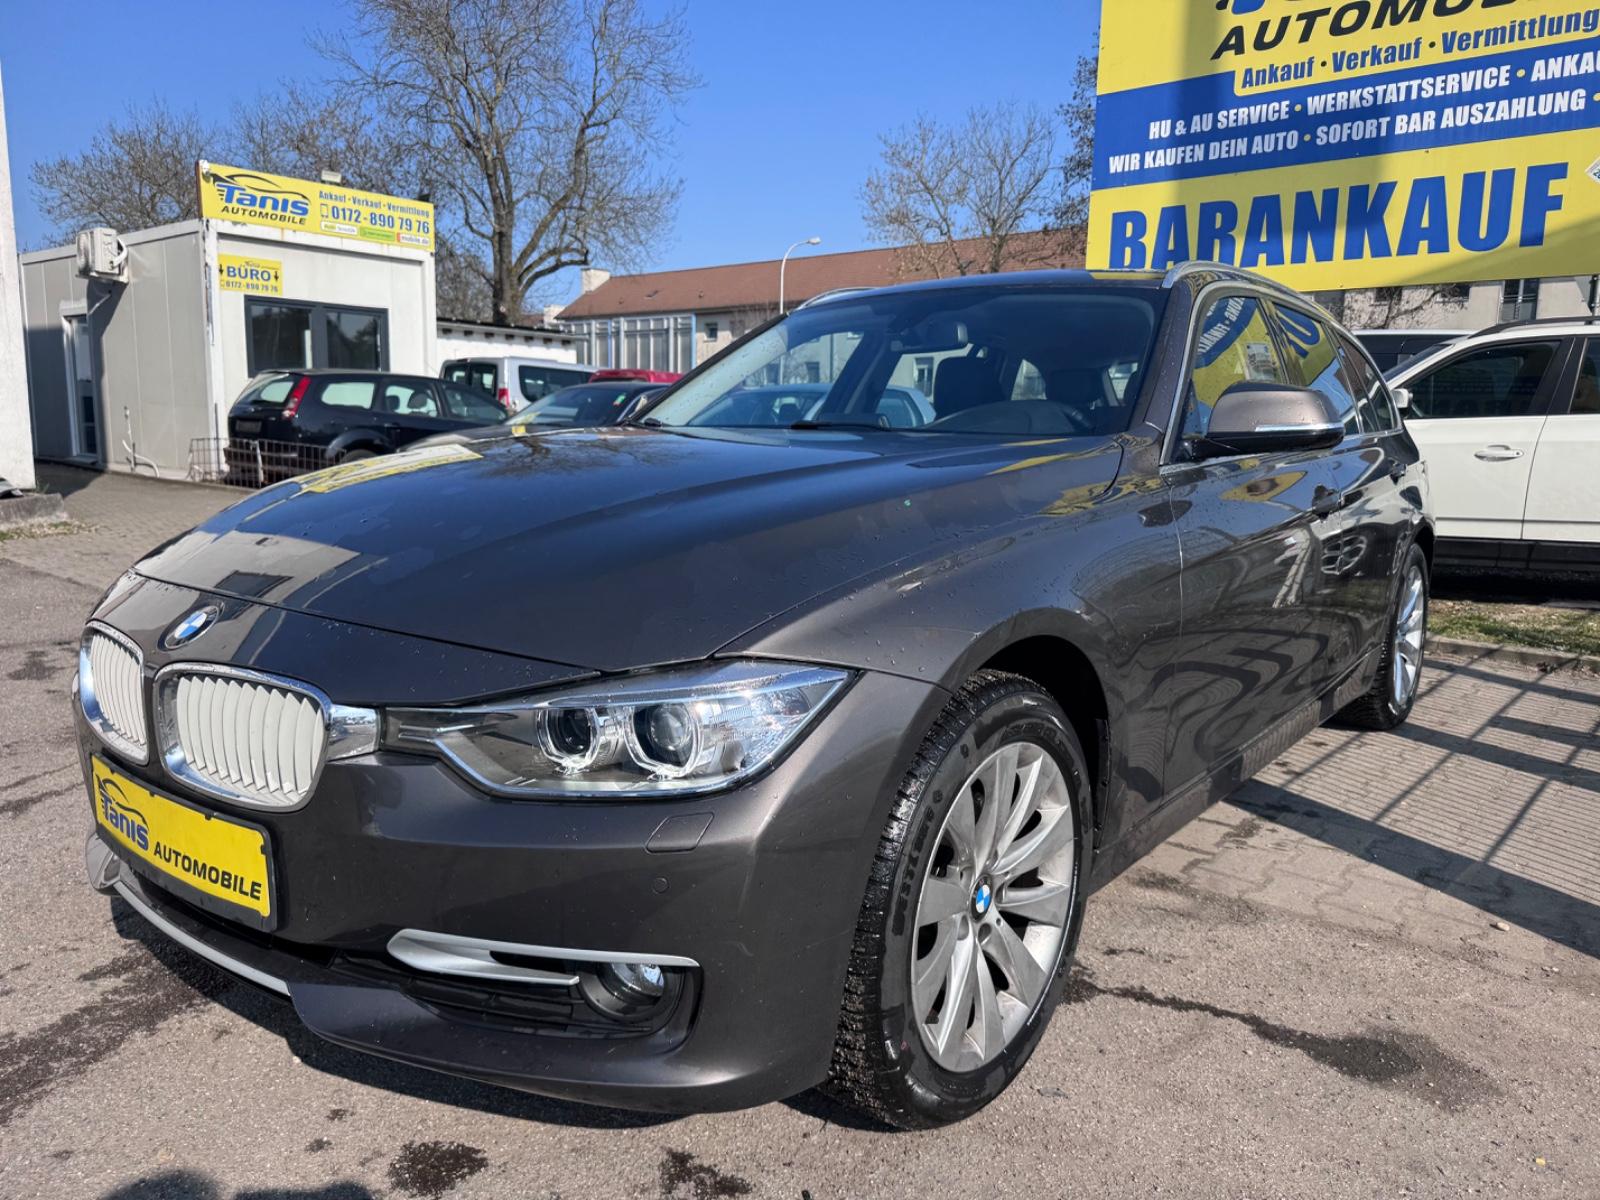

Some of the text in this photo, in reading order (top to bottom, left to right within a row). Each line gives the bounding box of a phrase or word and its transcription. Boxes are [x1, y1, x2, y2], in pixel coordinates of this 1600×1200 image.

[1241, 9, 1600, 89] Ankauf Verkauf Vermittlung
[1109, 89, 1587, 174] WIR KAUFEN DEIN AUTO SOFORT BAR AUSZAHLUNG
[1149, 50, 1600, 140] HU & AU SERVICE WERKSTATTSERVICE ANKA
[216, 183, 309, 216] Tanis
[221, 205, 306, 225] AUTOMOBILE
[319, 190, 346, 203] Ankauf
[352, 196, 382, 209] Verkauf
[398, 216, 412, 231] 79
[416, 219, 430, 234] 76
[1109, 162, 1568, 269] BARANKAUF
[101, 793, 262, 901] Tanis AUTOMOBILE
